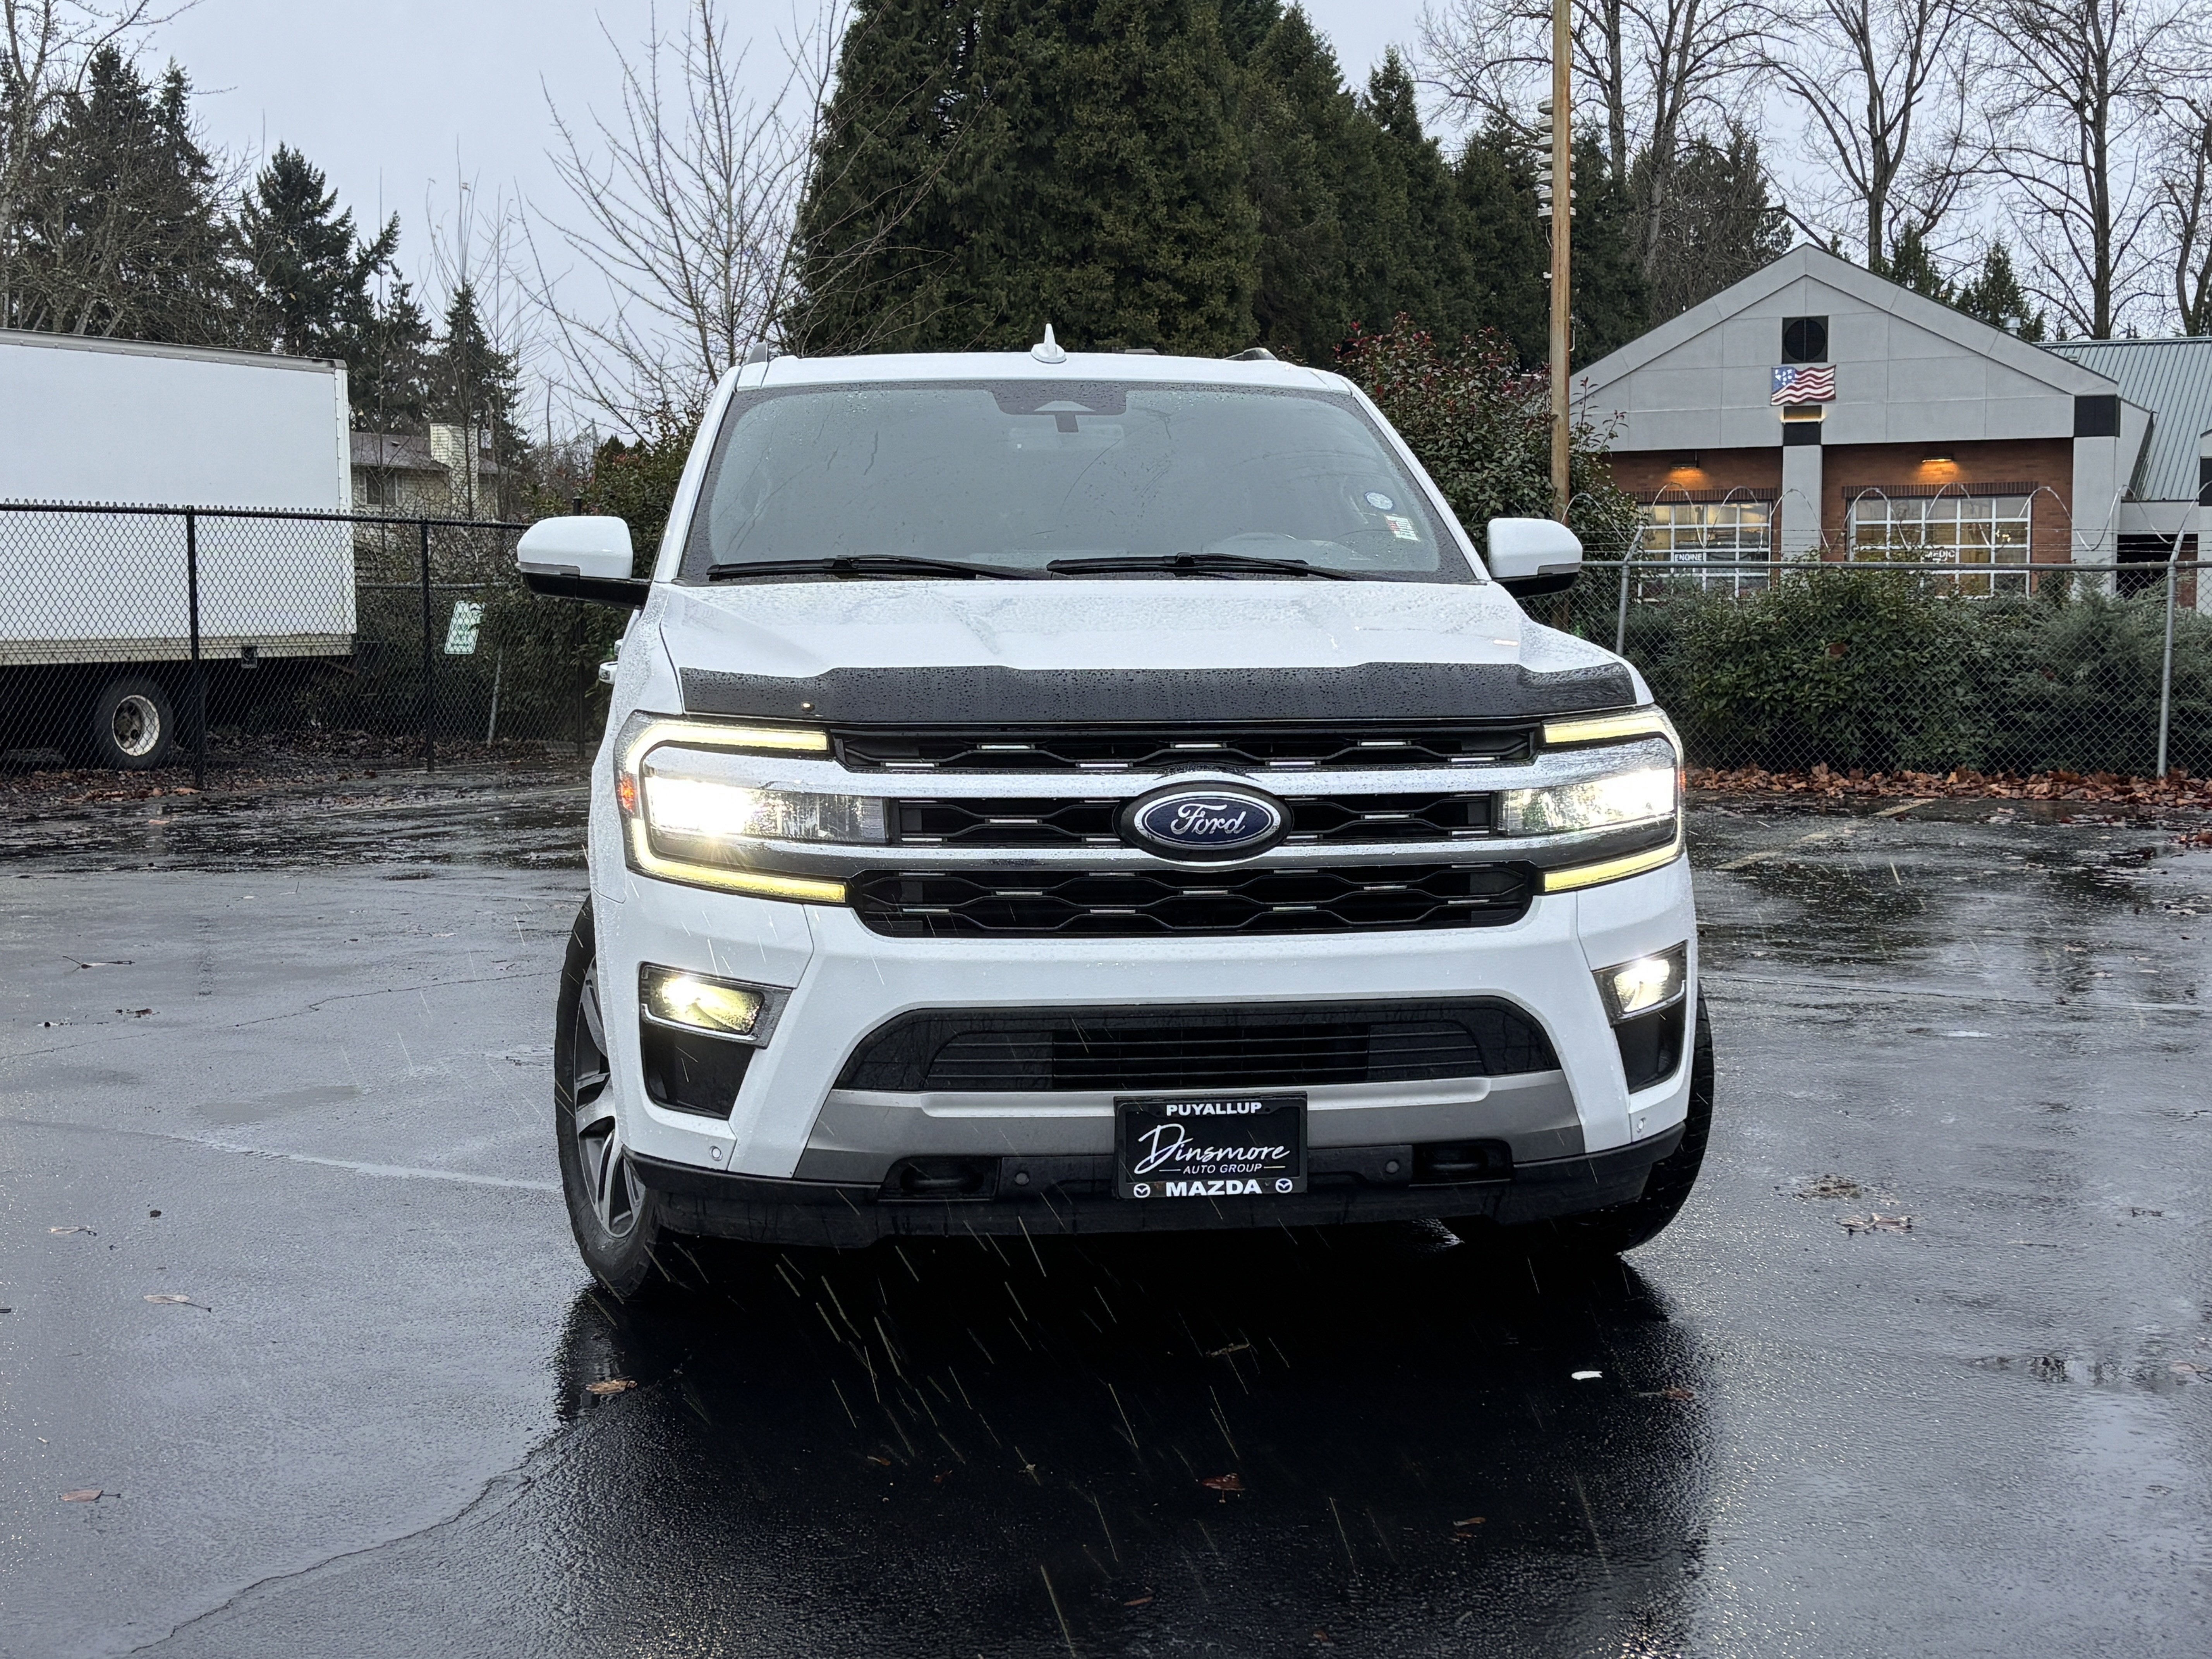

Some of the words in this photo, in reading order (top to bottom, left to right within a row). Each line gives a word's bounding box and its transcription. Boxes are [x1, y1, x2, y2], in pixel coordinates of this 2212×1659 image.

[1170, 803, 1247, 835] Ford
[1166, 1102, 1262, 1116] PUYALLUP
[1134, 1123, 1290, 1174] Dinsmore
[1183, 1165, 1216, 1174] AUTO
[1220, 1163, 1262, 1173] GROUP
[1166, 1180, 1262, 1197] MAZDA
